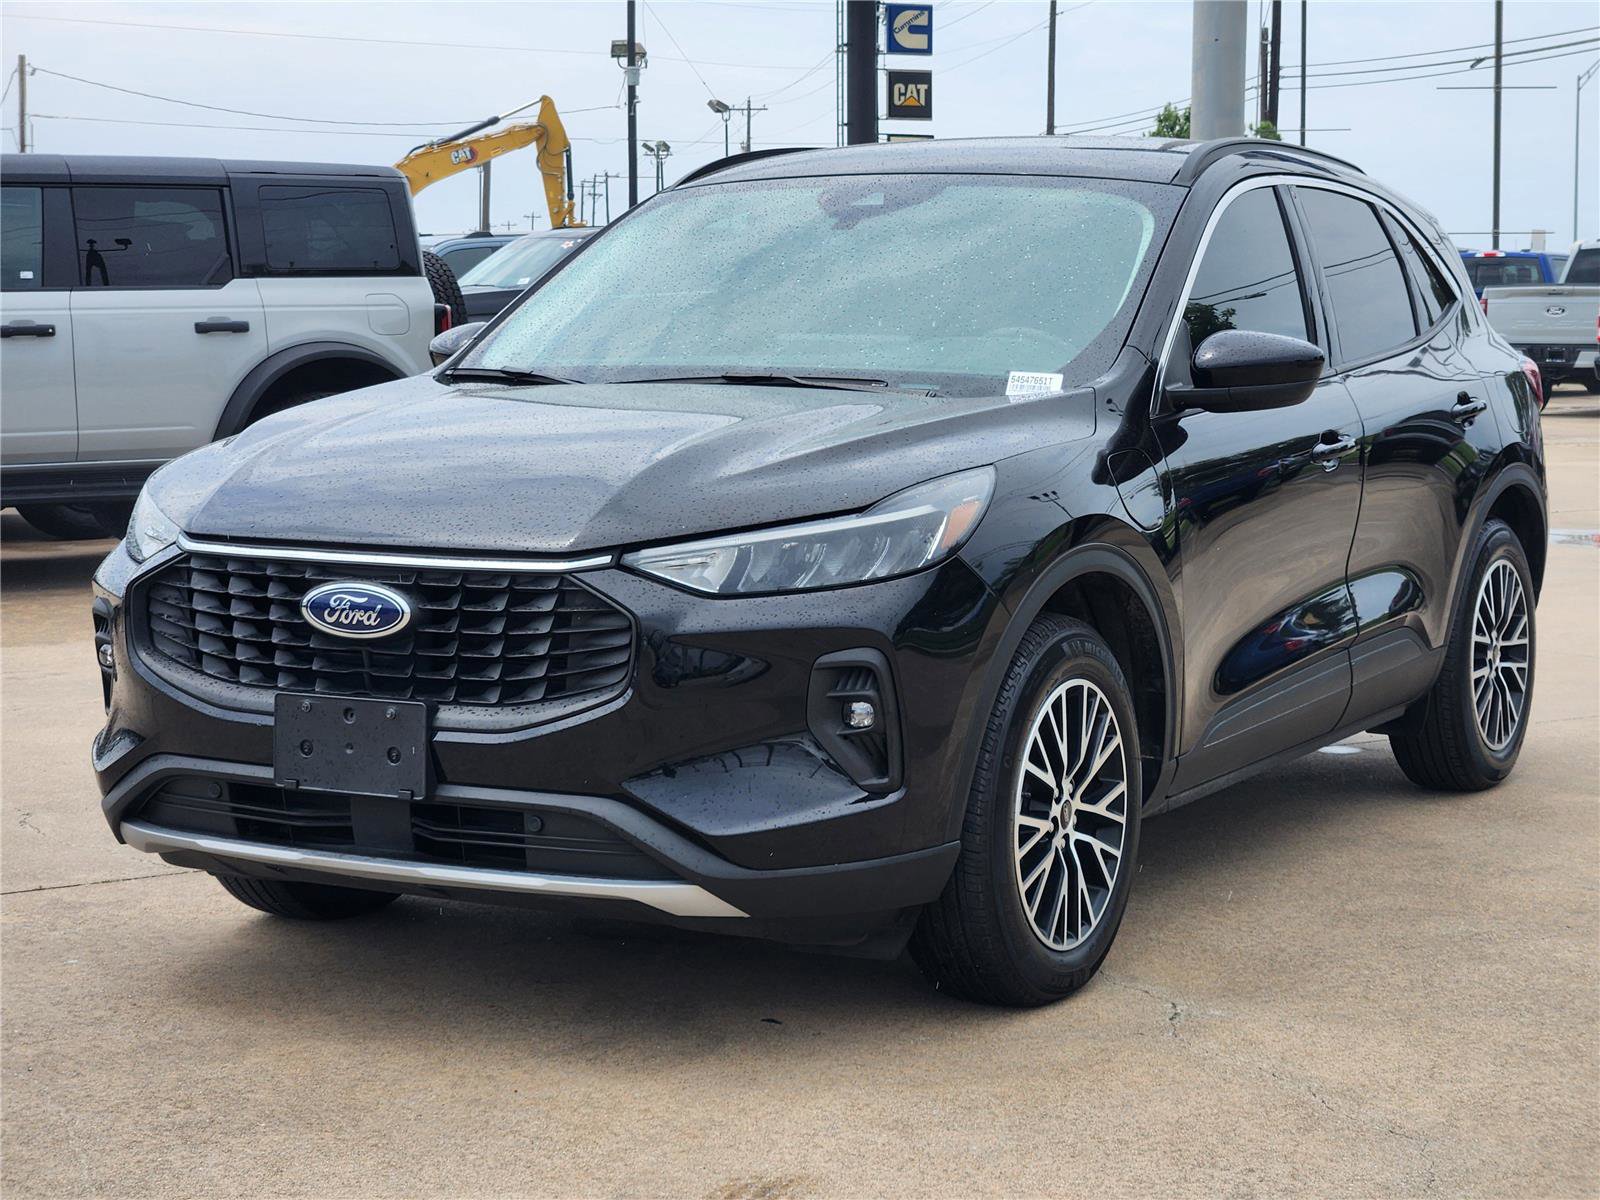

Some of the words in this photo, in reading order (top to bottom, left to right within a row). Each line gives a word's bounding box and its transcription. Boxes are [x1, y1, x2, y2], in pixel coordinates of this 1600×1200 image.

[893, 11, 925, 34] Cummins
[893, 83, 928, 107] CAT
[451, 147, 472, 164] CAT
[324, 594, 382, 626] Ford
